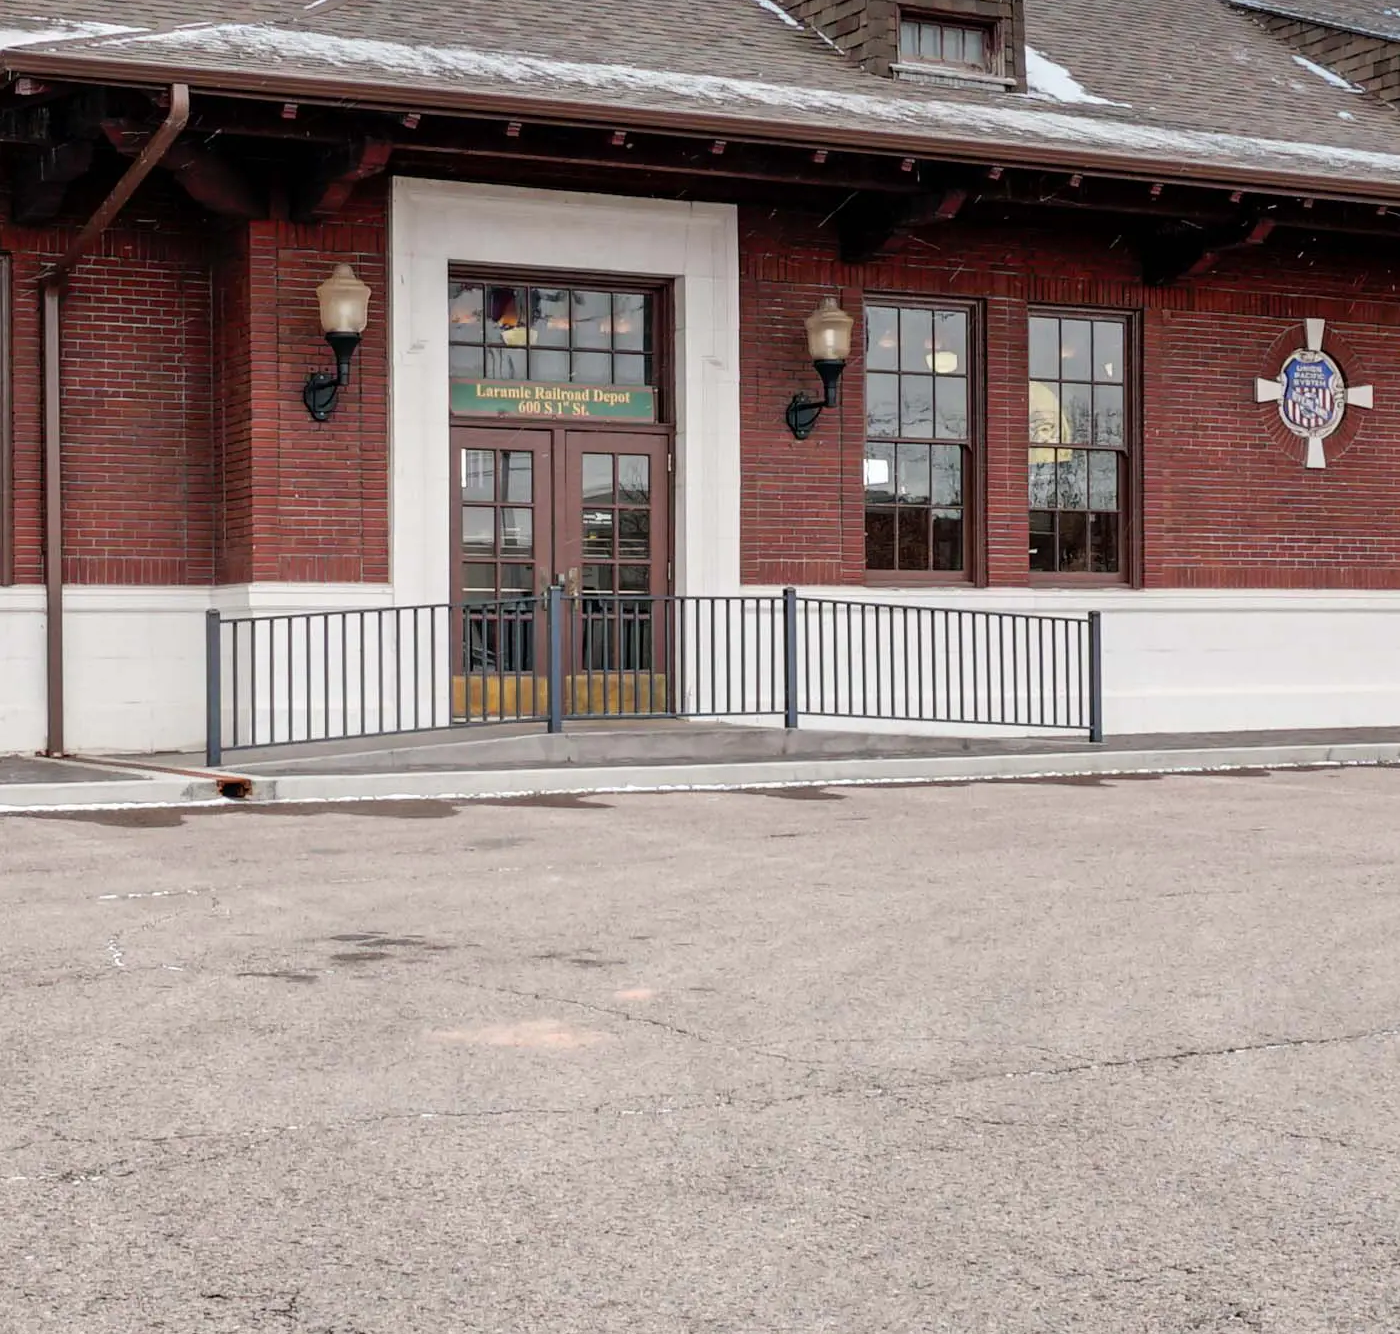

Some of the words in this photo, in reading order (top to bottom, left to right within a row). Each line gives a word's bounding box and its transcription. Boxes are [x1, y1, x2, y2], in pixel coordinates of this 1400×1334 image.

[476, 383, 531, 399] Laramie
[535, 386, 589, 401] Railroad
[593, 389, 630, 406] Depot
[518, 401, 541, 413] 600
[544, 402, 553, 415] S
[572, 402, 589, 416] St.
